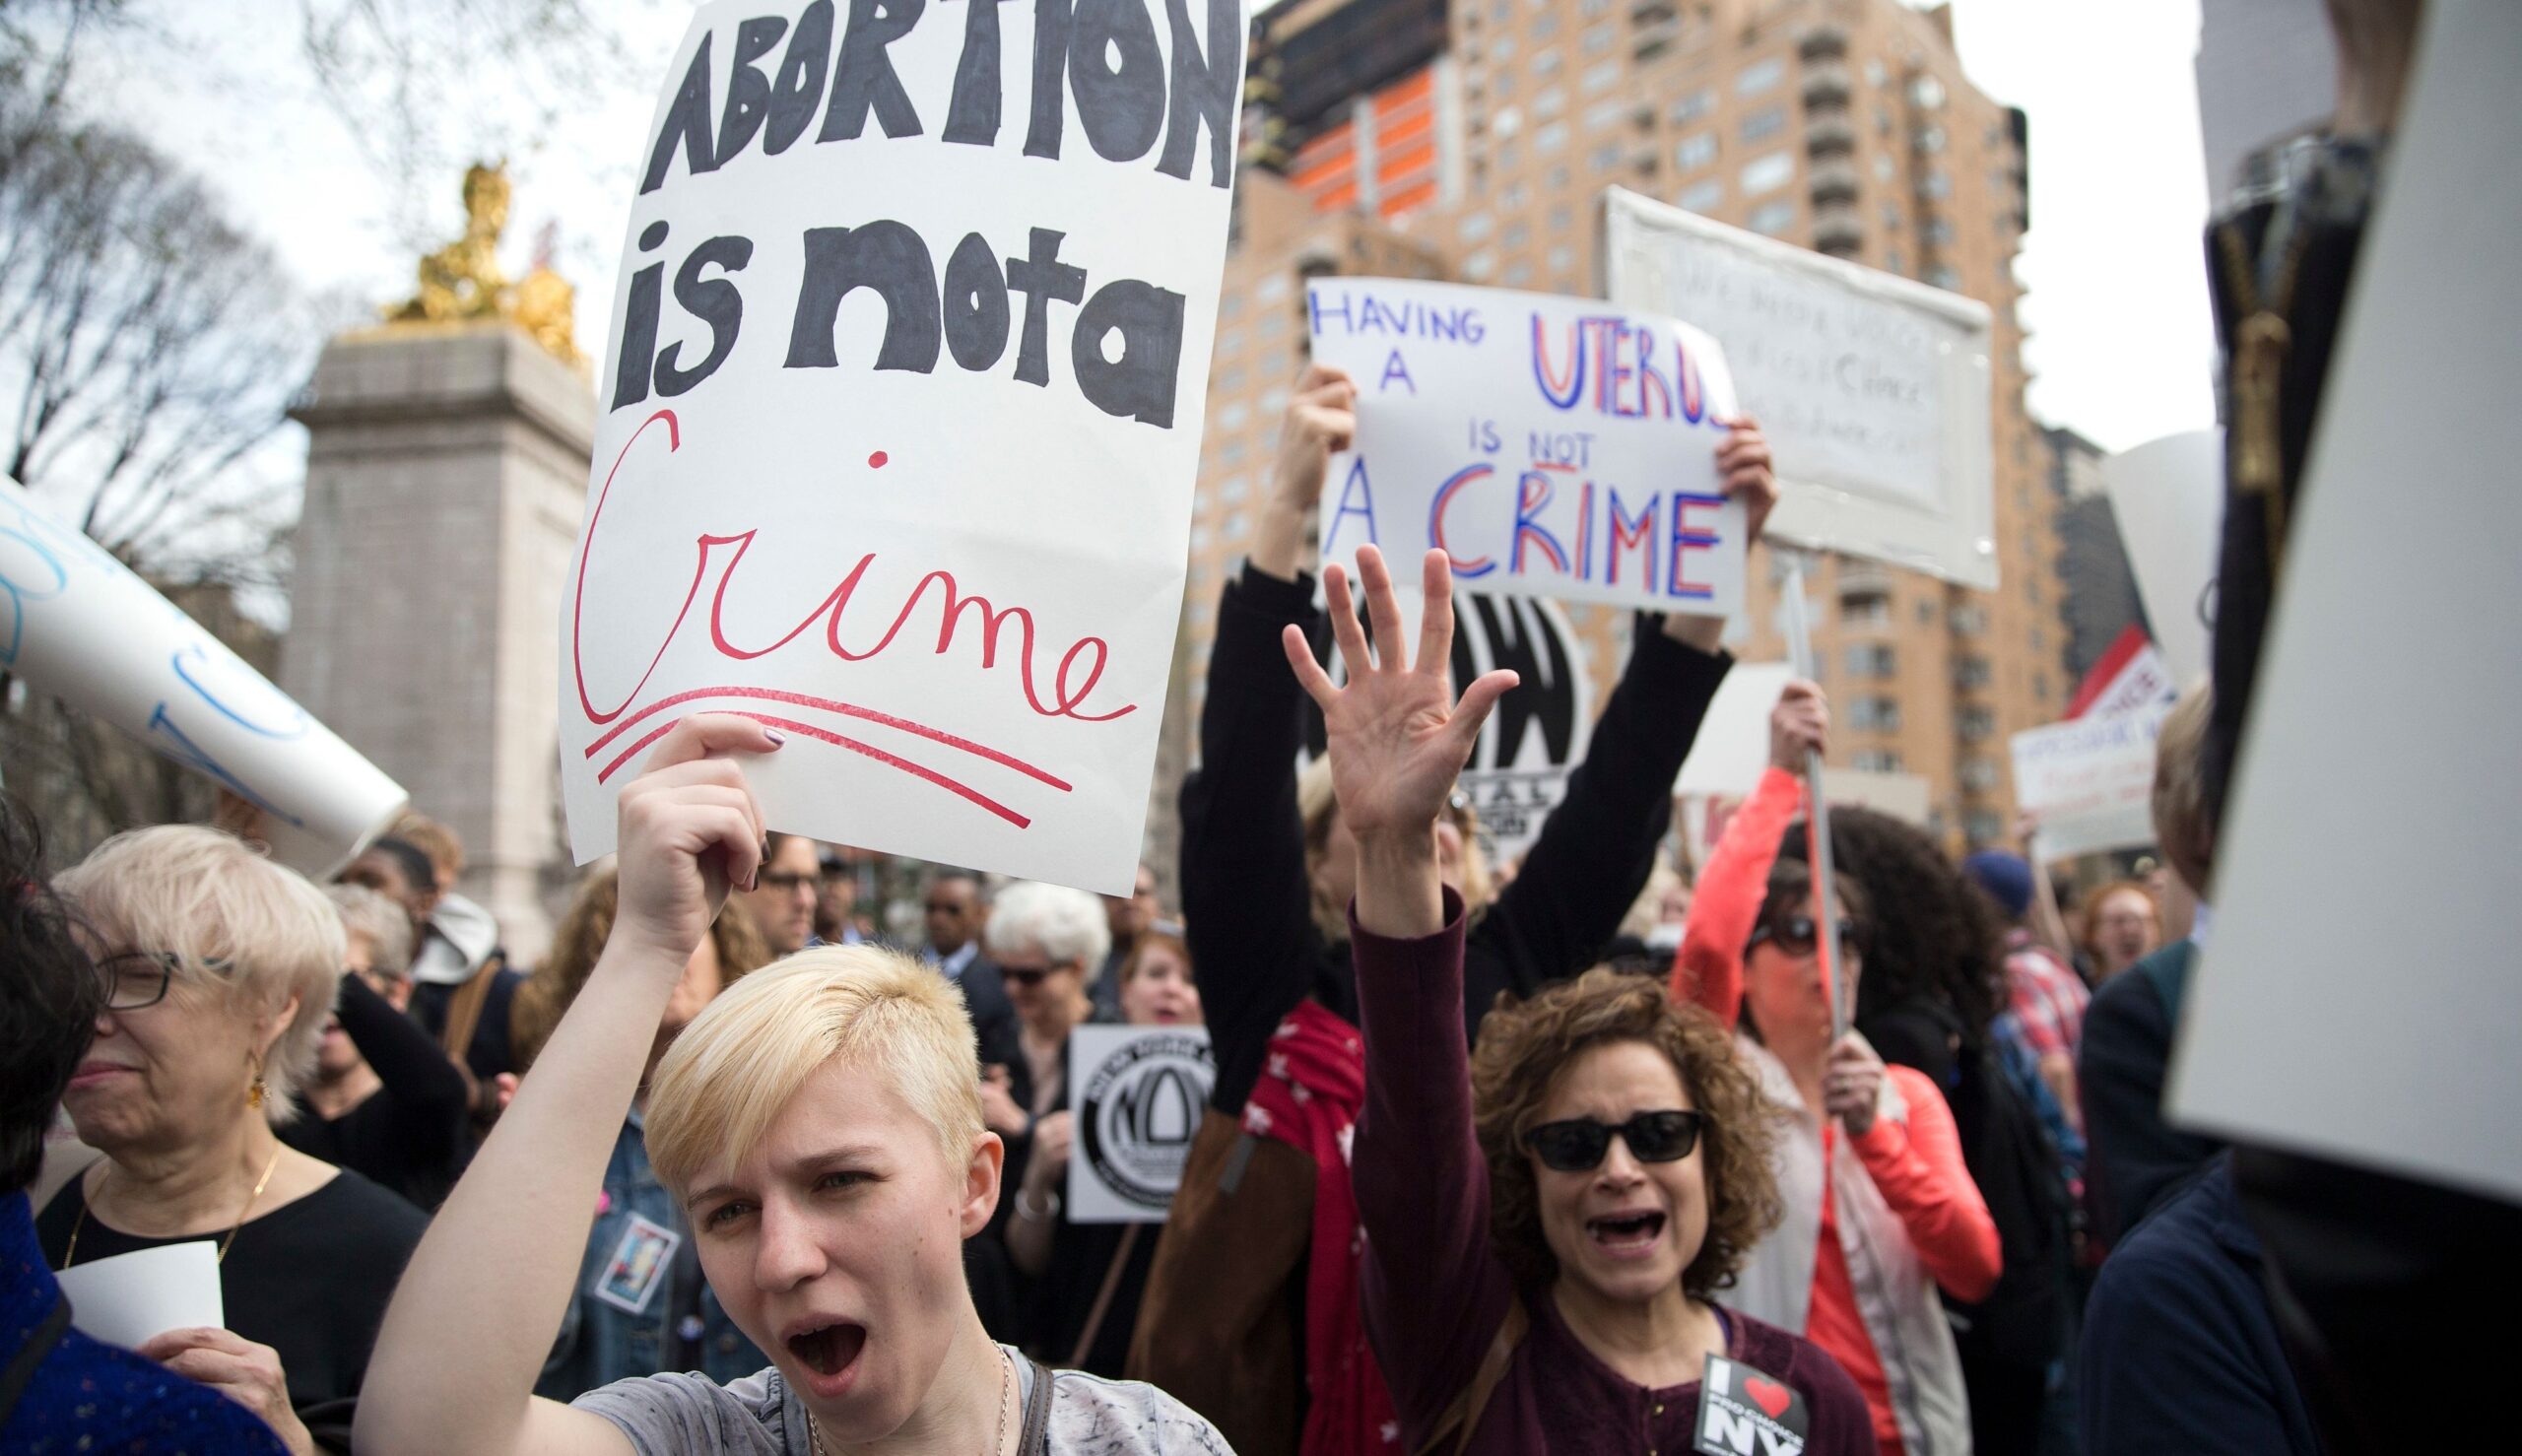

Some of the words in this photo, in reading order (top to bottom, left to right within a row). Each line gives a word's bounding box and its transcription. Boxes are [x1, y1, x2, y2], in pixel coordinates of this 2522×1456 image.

[639, 0, 1239, 195] ABORTION
[610, 220, 754, 414] is
[1310, 291, 1486, 346] HAVING
[1380, 349, 1417, 395] A
[1532, 312, 1732, 430] UTERU
[1469, 418, 1502, 454] IS
[1528, 430, 1596, 469] NOT
[573, 409, 1138, 725] Crime
[1324, 454, 1377, 556] A
[1428, 463, 1730, 600] CRIME
[1707, 1391, 1745, 1416] PRO
[1745, 1409, 1805, 1446] CHOICE
[1708, 1357, 1732, 1396] I
[1703, 1403, 1803, 1456] NY
